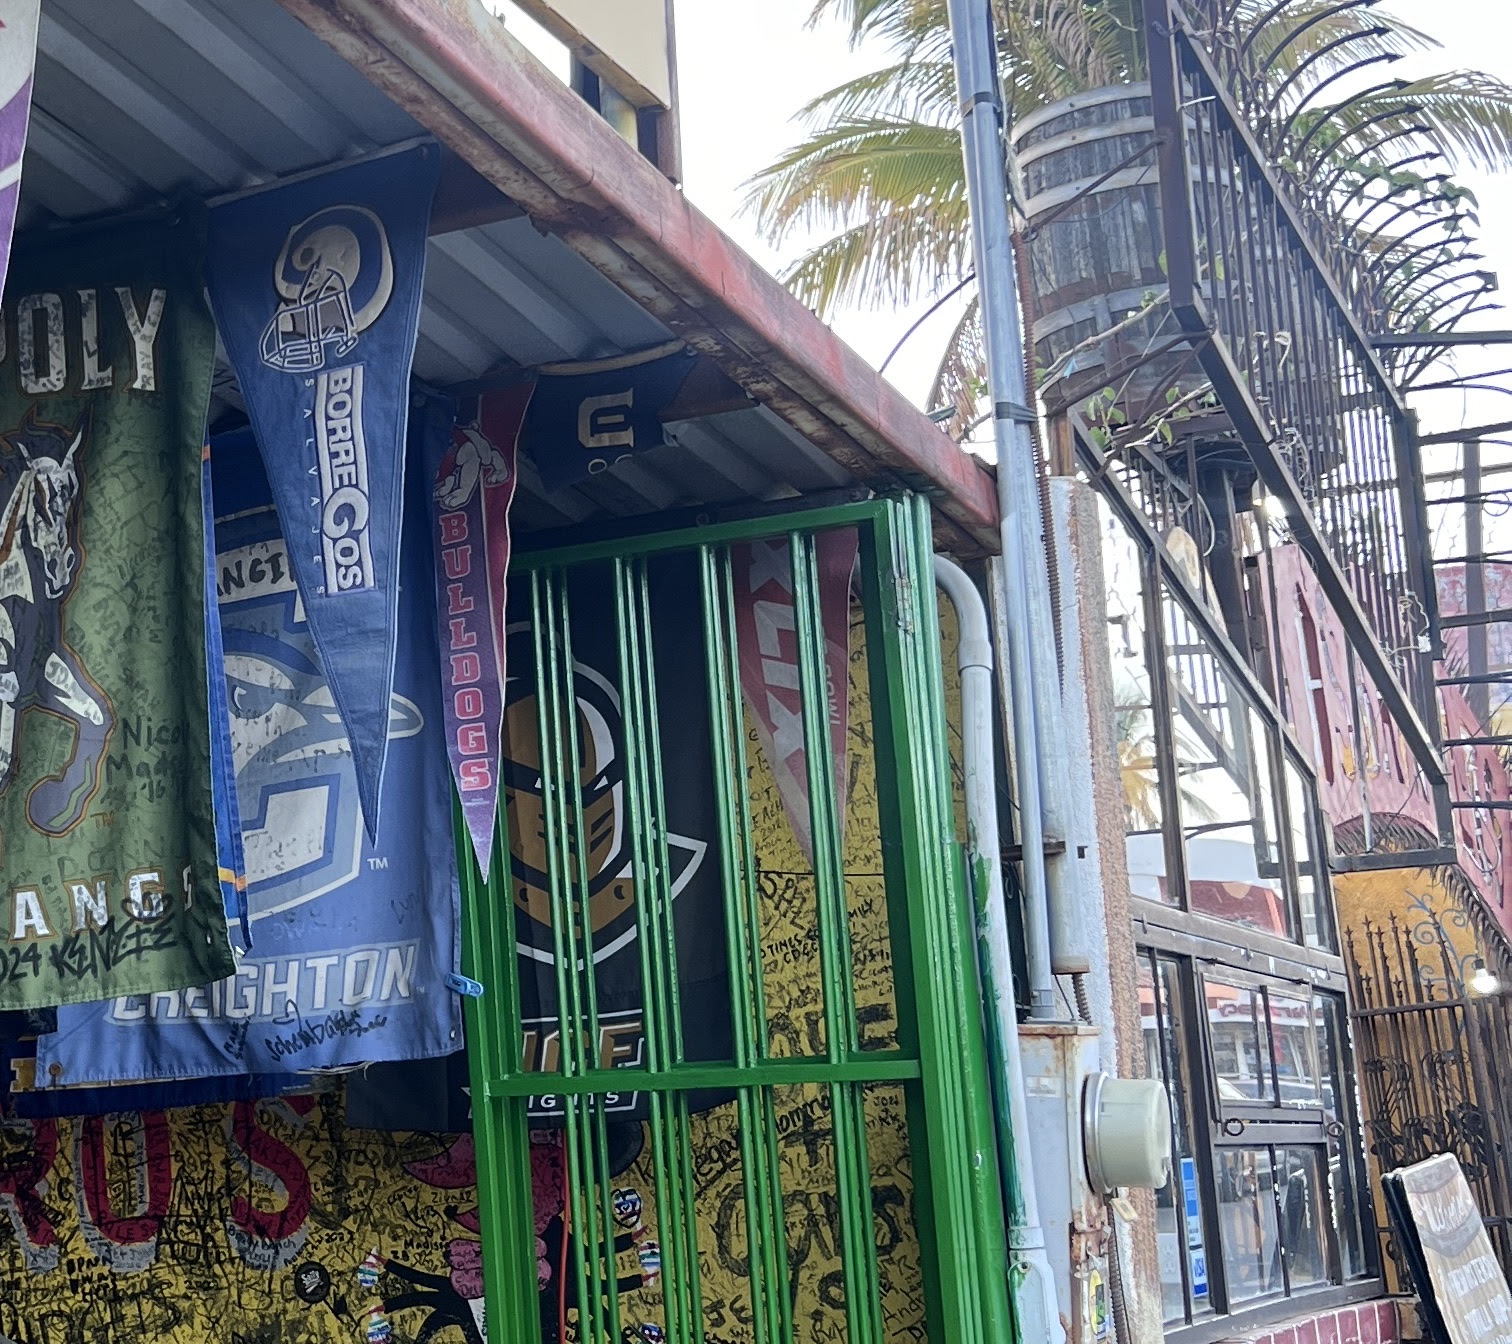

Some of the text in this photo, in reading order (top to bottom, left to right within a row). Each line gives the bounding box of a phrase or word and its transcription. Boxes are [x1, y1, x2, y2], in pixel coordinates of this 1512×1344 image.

[302, 376, 326, 597] SALVAJES
[322, 364, 371, 592] BORREGOS
[437, 510, 493, 793] BULLDOGS
